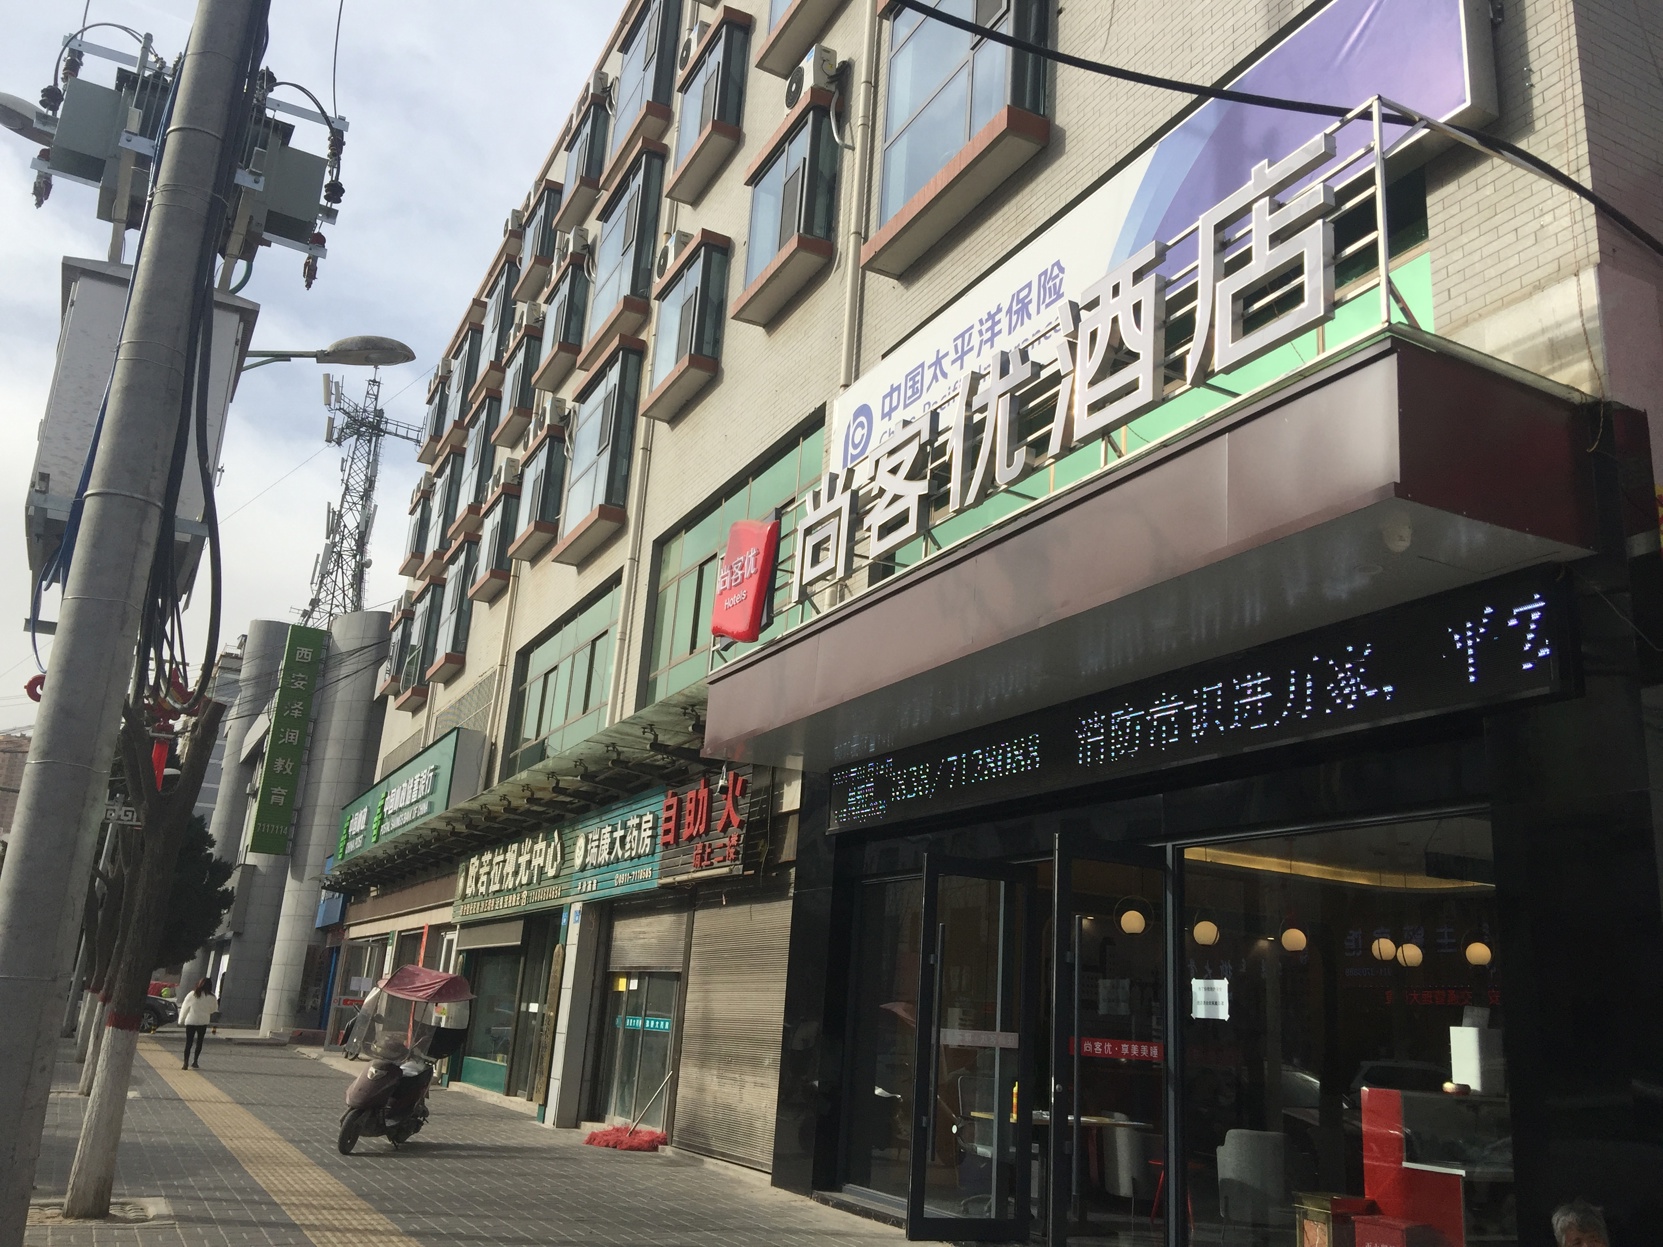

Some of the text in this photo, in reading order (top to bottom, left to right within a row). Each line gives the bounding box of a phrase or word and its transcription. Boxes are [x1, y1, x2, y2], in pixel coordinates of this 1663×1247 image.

[881, 258, 1066, 422] 中国太平洋保险
[793, 132, 1337, 604] 尚客优酒店
[717, 547, 760, 595] 尚客优
[724, 589, 748, 611] Hotels
[269, 646, 313, 806] 西安泽润教育
[585, 811, 655, 869] 瑞康大药房
[692, 832, 739, 869] 请上二楼
[1083, 1041, 1159, 1059] 尚客优·享美美睡
